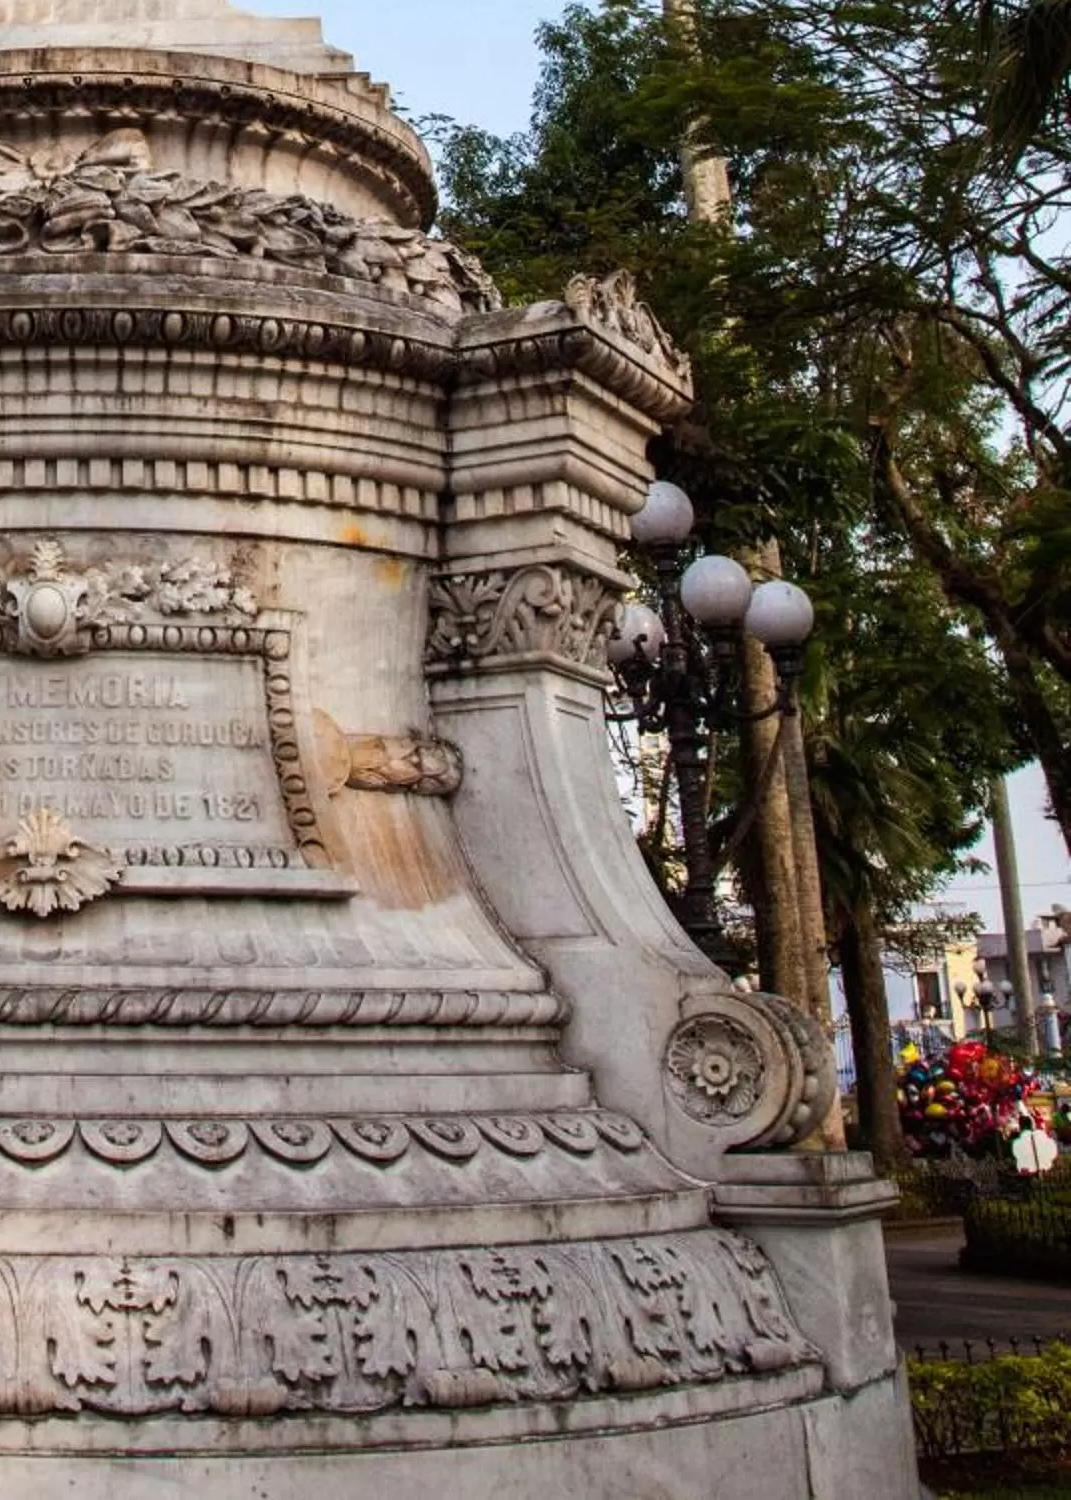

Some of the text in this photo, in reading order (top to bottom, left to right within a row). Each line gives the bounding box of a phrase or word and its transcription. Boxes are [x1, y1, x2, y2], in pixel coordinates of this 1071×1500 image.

[7, 673, 191, 711] MEMORIA
[106, 717, 141, 746] DE
[23, 752, 175, 782] JORNADAS
[17, 790, 60, 818] DE
[64, 789, 146, 820] MAYO
[153, 788, 194, 820] DE
[201, 789, 262, 822] 1821
